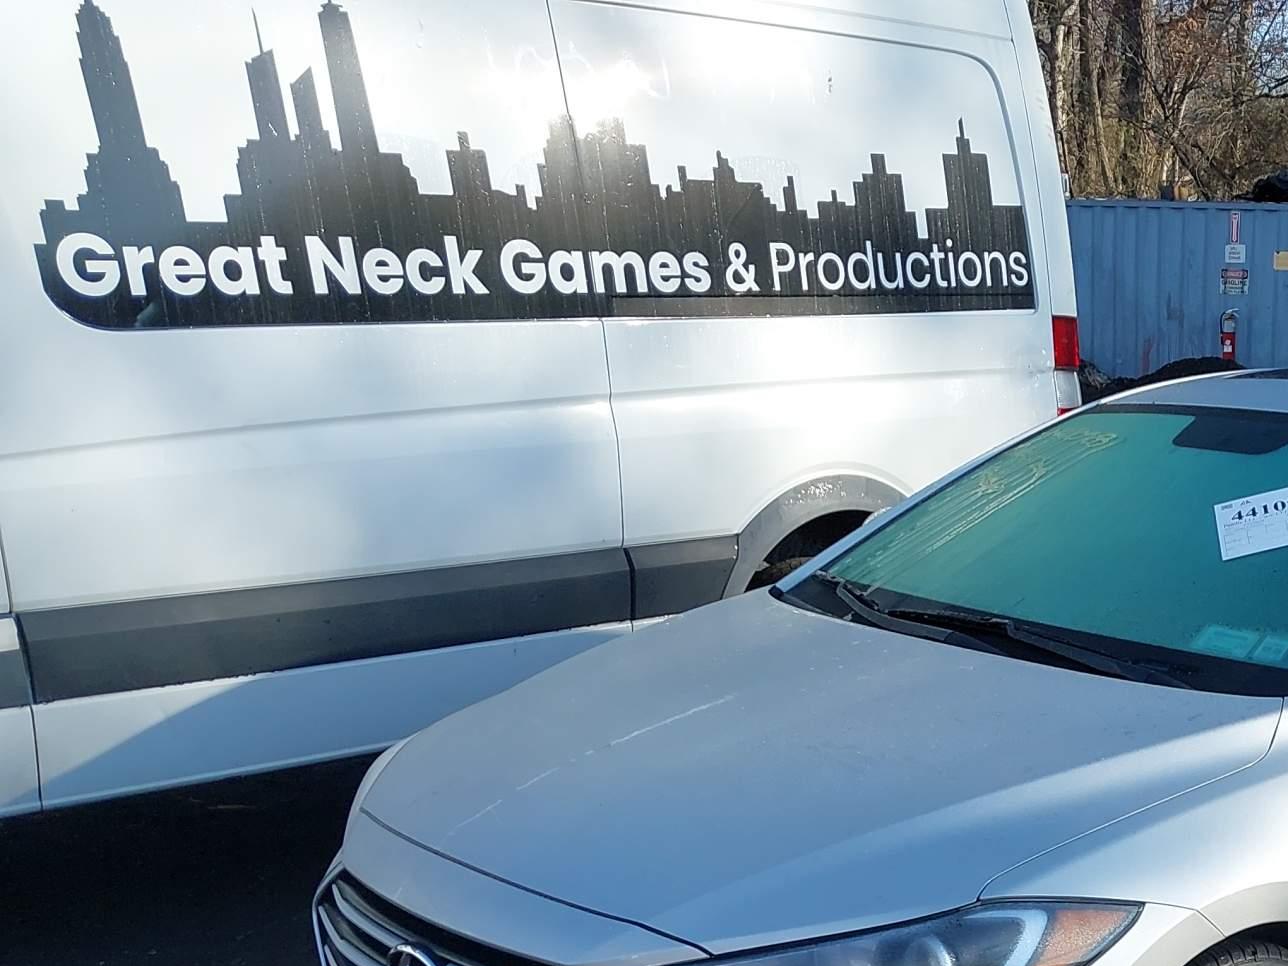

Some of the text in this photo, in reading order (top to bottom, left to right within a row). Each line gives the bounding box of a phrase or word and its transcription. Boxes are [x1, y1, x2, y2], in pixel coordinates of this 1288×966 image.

[56, 232, 1030, 296] Great Neck Games & Productions
